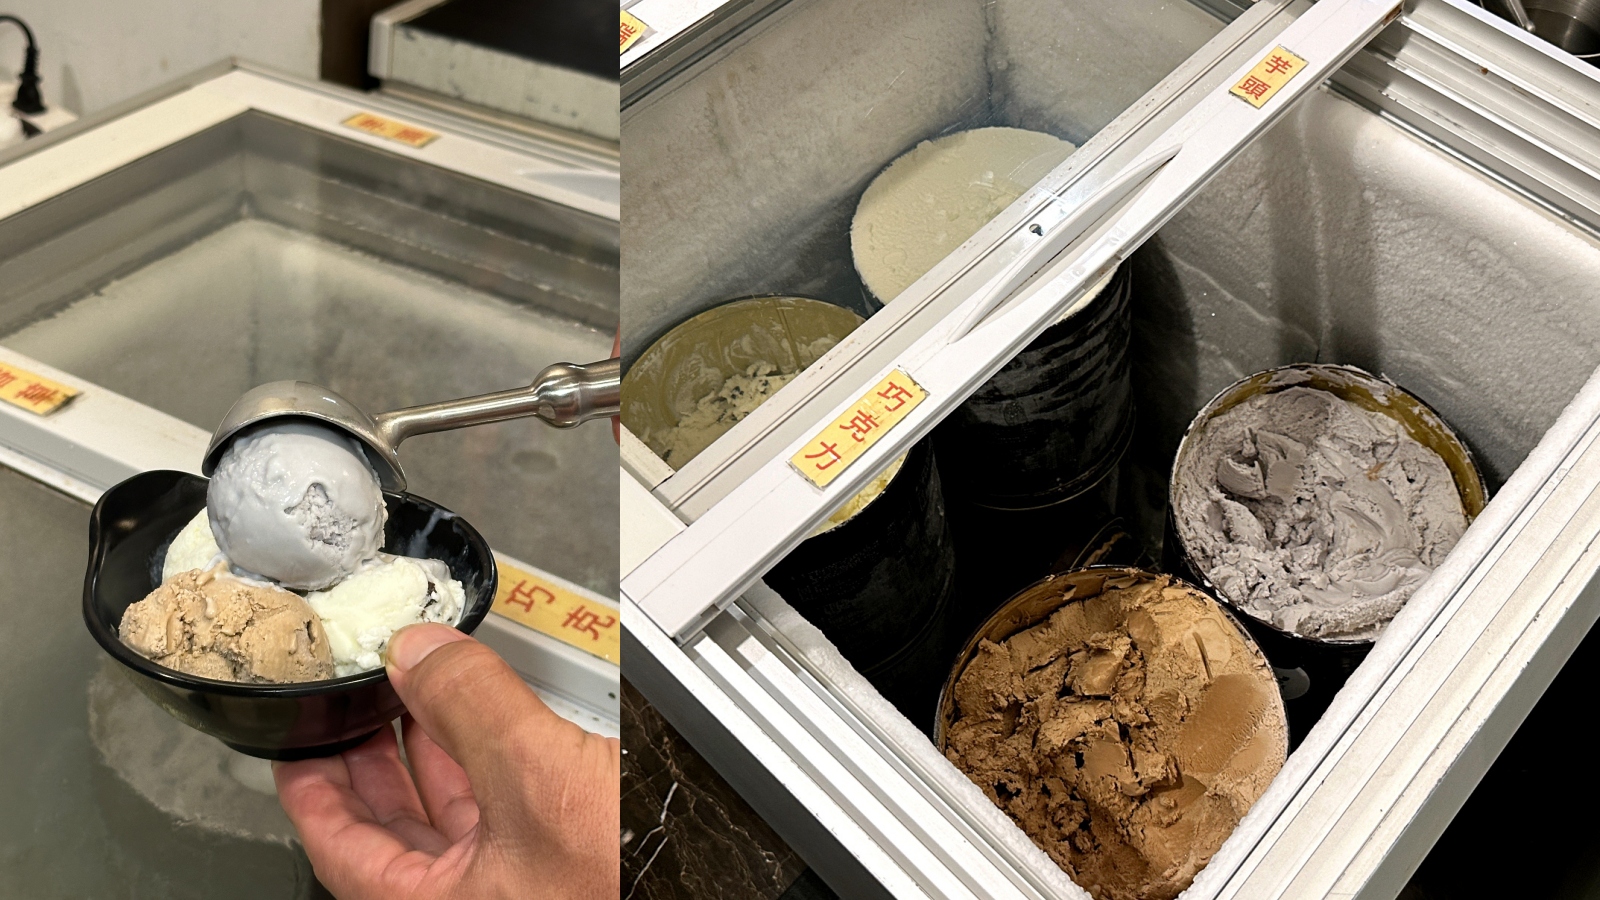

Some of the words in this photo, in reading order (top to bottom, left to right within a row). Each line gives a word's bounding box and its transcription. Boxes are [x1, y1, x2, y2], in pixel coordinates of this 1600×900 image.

[1238, 55, 1293, 100] 芋頭
[804, 381, 913, 470] 巧克力
[504, 579, 616, 640] 巧克
